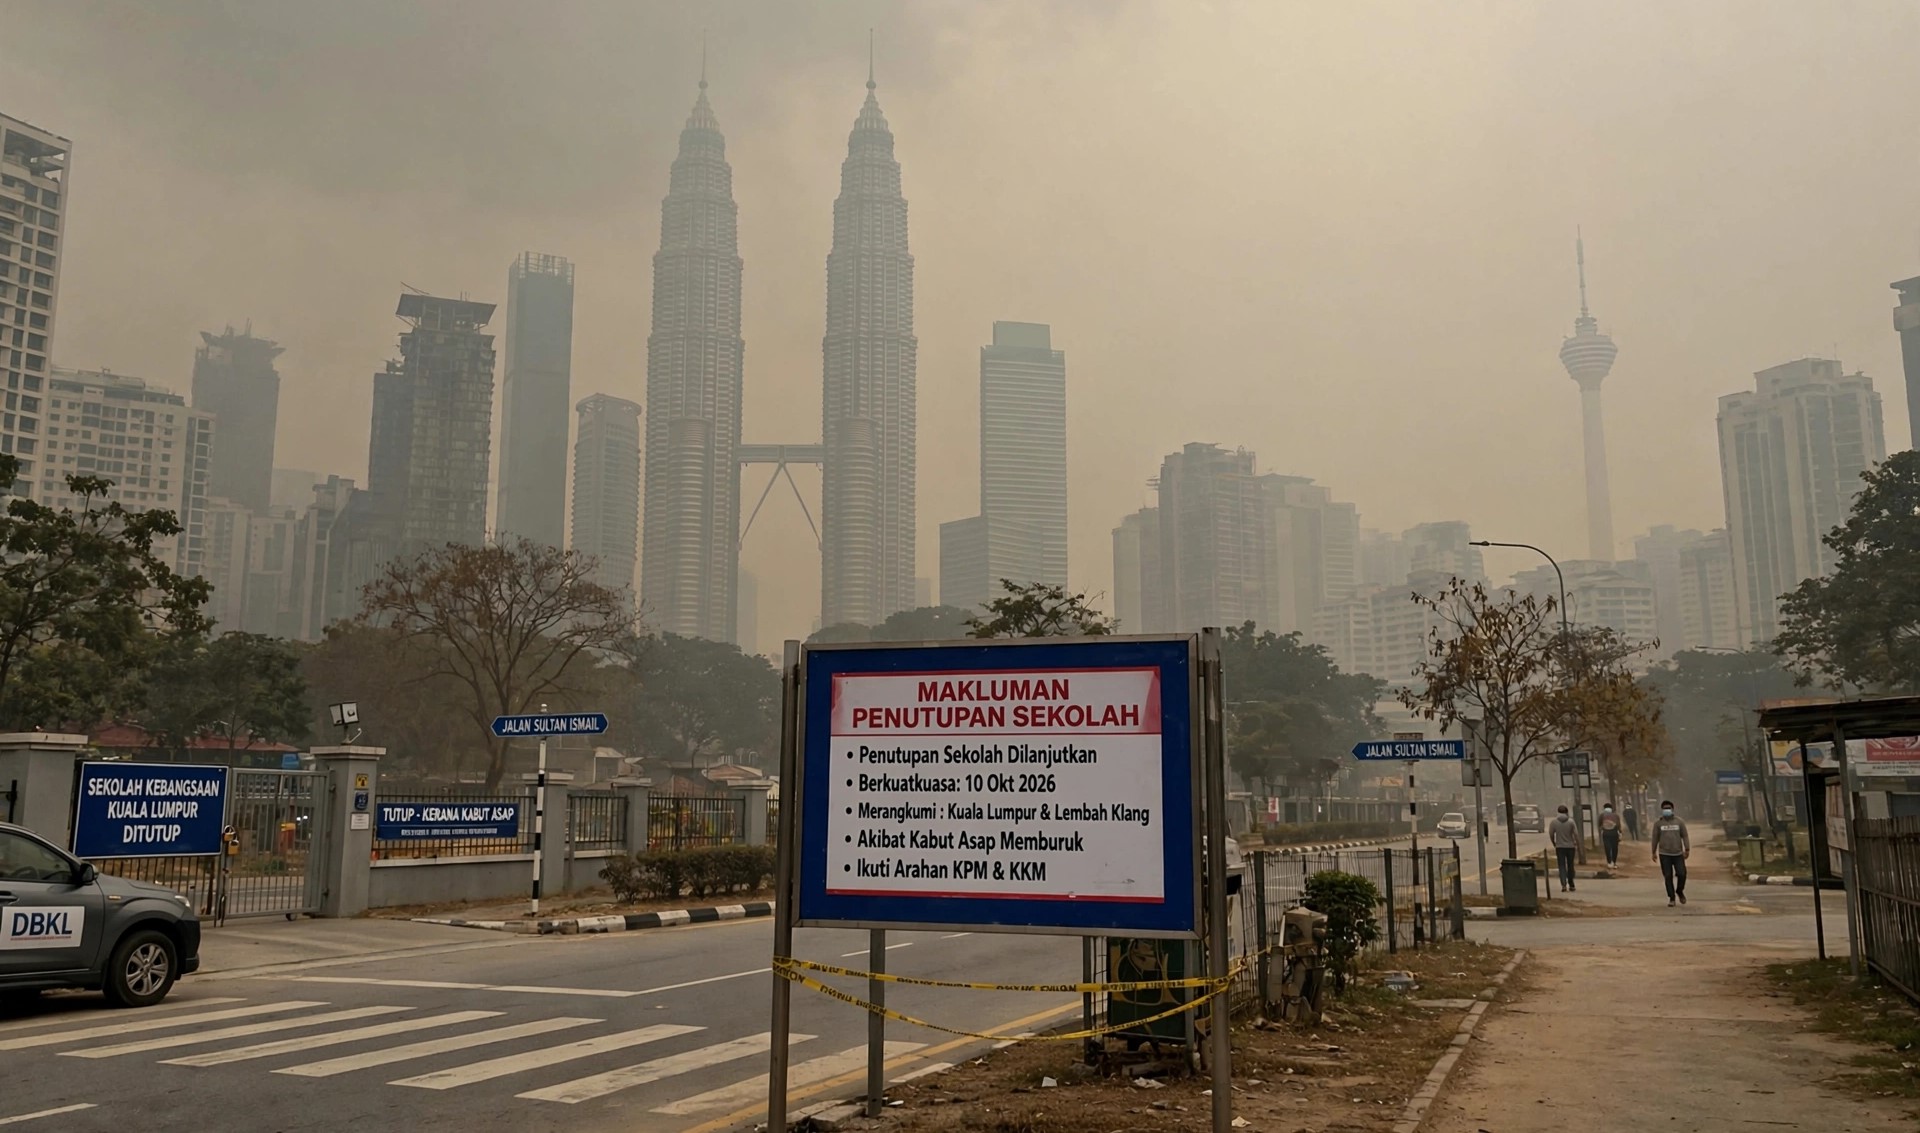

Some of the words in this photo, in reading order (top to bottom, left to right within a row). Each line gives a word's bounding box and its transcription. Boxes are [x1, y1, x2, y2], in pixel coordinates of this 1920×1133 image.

[918, 679, 1069, 702] MAKLUMAN
[503, 719, 531, 733] JALAN
[534, 717, 567, 731] SULTAN
[570, 717, 599, 731] ISMAIL
[853, 706, 1004, 728] PENUTUPAN
[1013, 705, 1139, 727] SEKOLAH
[860, 746, 938, 768] Penutupan
[944, 744, 1002, 763] Sekolah
[1008, 744, 1096, 768] Dilanjutkan
[1366, 744, 1392, 757] JALAN
[1395, 744, 1426, 757] SULTAN
[1429, 743, 1457, 756] ISMAIL
[88, 778, 142, 796] SEKOLAH
[146, 779, 219, 796] KEBANGSAAN
[859, 773, 960, 792] Berkuatkuasa:
[966, 774, 983, 792] 10
[987, 773, 1014, 792] Okt
[1019, 774, 1056, 792] 2026
[108, 801, 147, 819] KUALA
[151, 801, 198, 818] LUMPUR
[383, 808, 414, 821] TUTUP
[422, 807, 459, 821] KERANA
[462, 808, 489, 821] KABUT
[491, 807, 514, 821] ASAP
[859, 802, 936, 823] Merangkumi
[948, 802, 983, 819] Kuala
[988, 803, 1037, 825] Lumpur
[1040, 804, 1050, 822] &
[1055, 803, 1107, 821] Lembah
[1112, 803, 1149, 826] Klang
[123, 825, 181, 843] DITUTUP
[858, 829, 905, 848] Akibat
[910, 829, 954, 849] Kabut
[958, 831, 995, 855] Asap
[1001, 831, 1084, 851] Memburuk
[858, 858, 890, 877] Ikuti
[894, 859, 948, 878] Arahan
[953, 860, 987, 879] KPM
[993, 862, 1004, 880] &
[1010, 862, 1045, 881] KKM
[12, 912, 72, 936] DBKL
